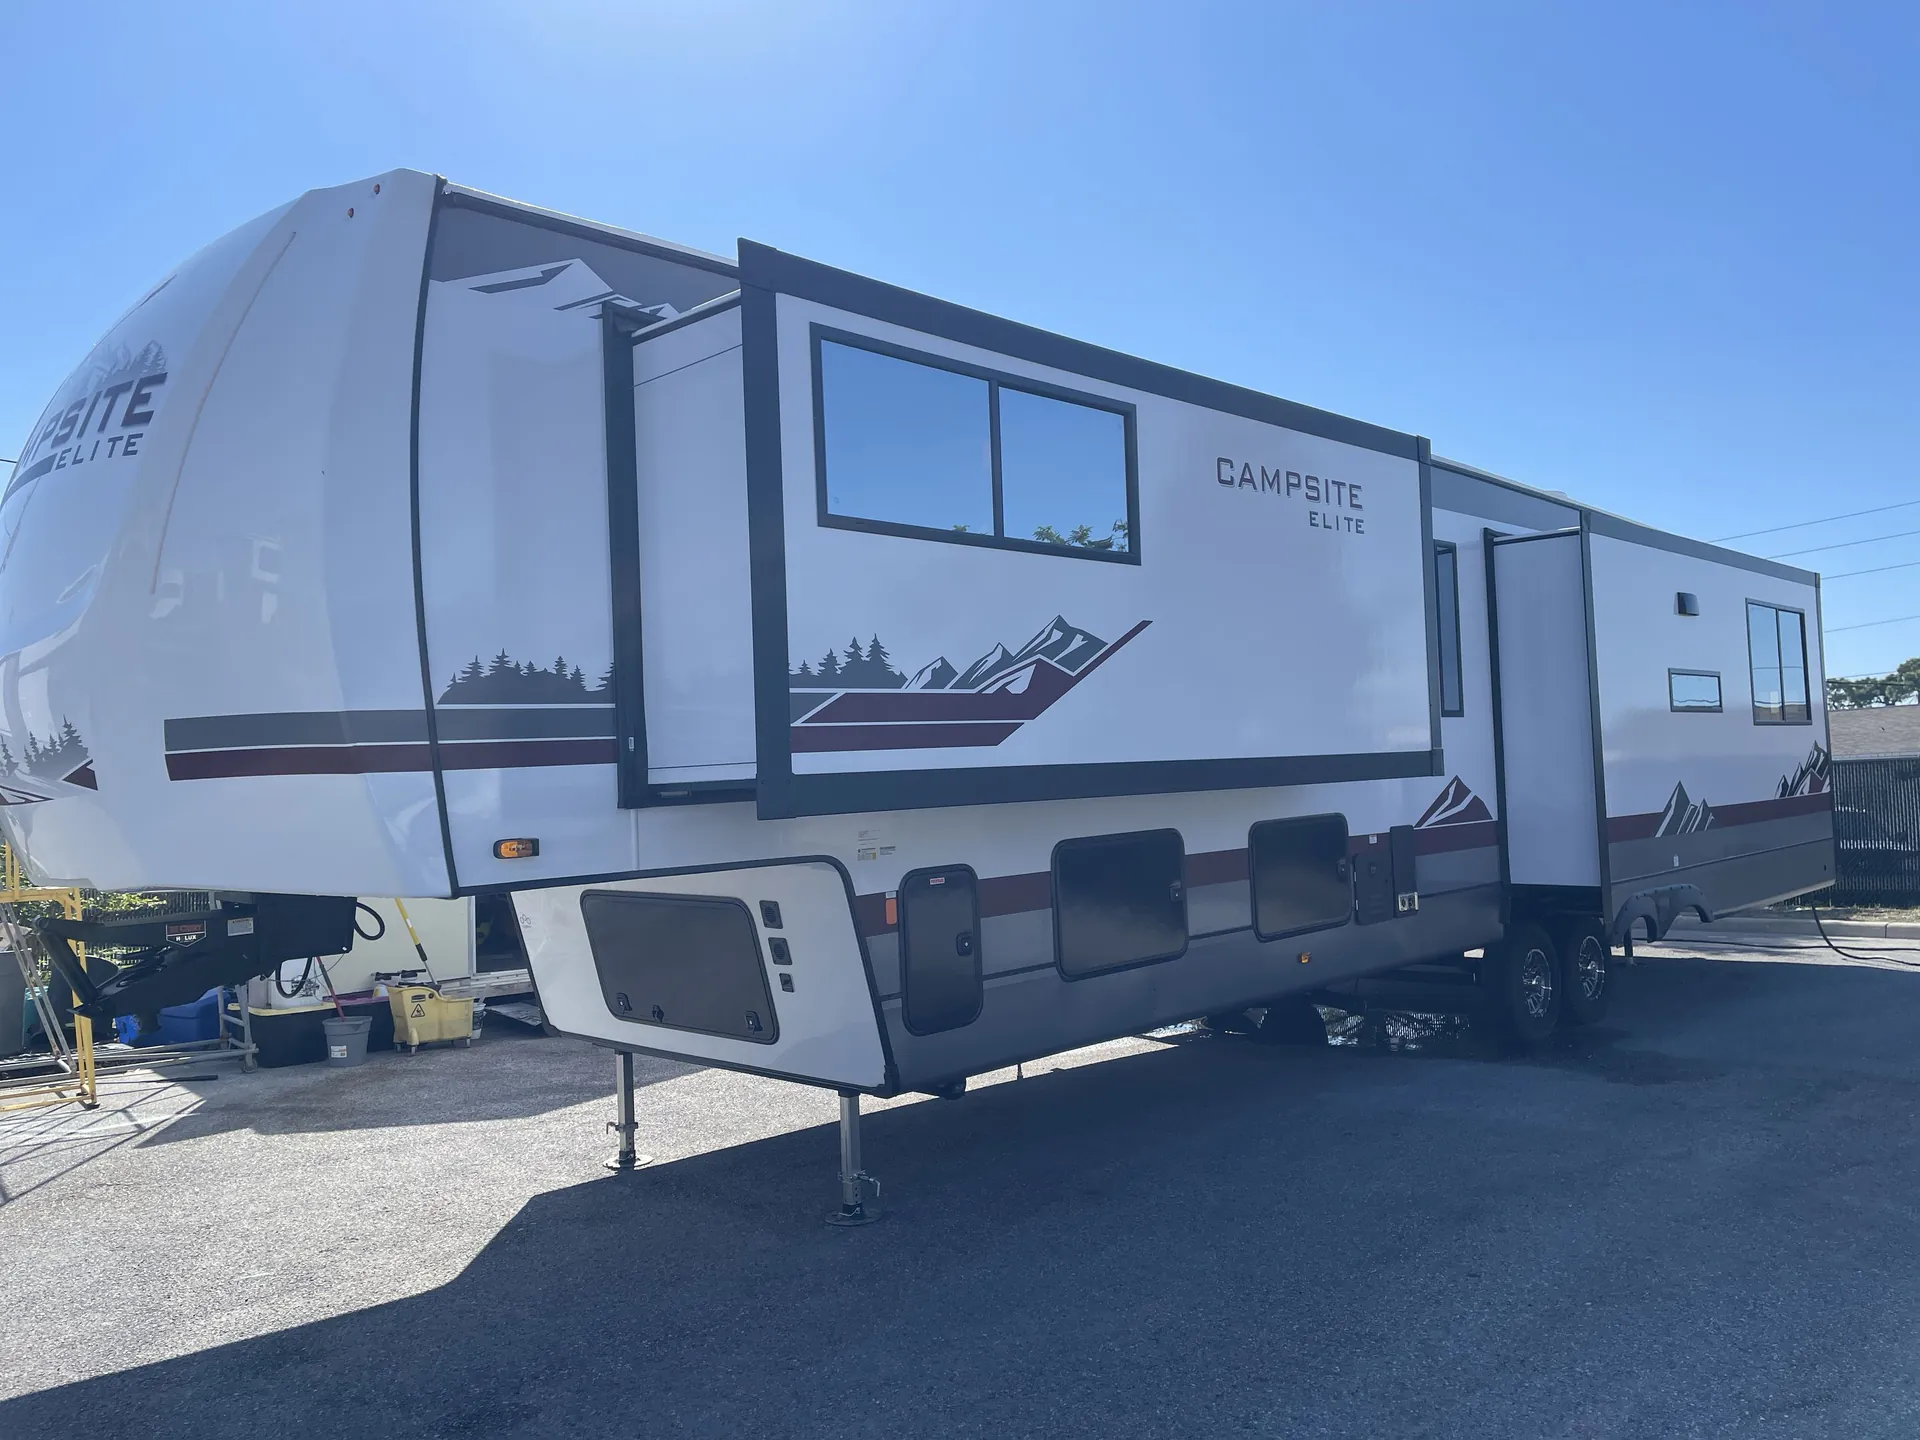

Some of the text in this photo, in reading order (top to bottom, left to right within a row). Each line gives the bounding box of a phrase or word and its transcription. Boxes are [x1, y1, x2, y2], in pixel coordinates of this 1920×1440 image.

[20, 372, 168, 468] MPSITE
[55, 433, 143, 470] ELITE
[1216, 456, 1364, 511] CAMPSITE
[1309, 510, 1365, 534] ELITE
